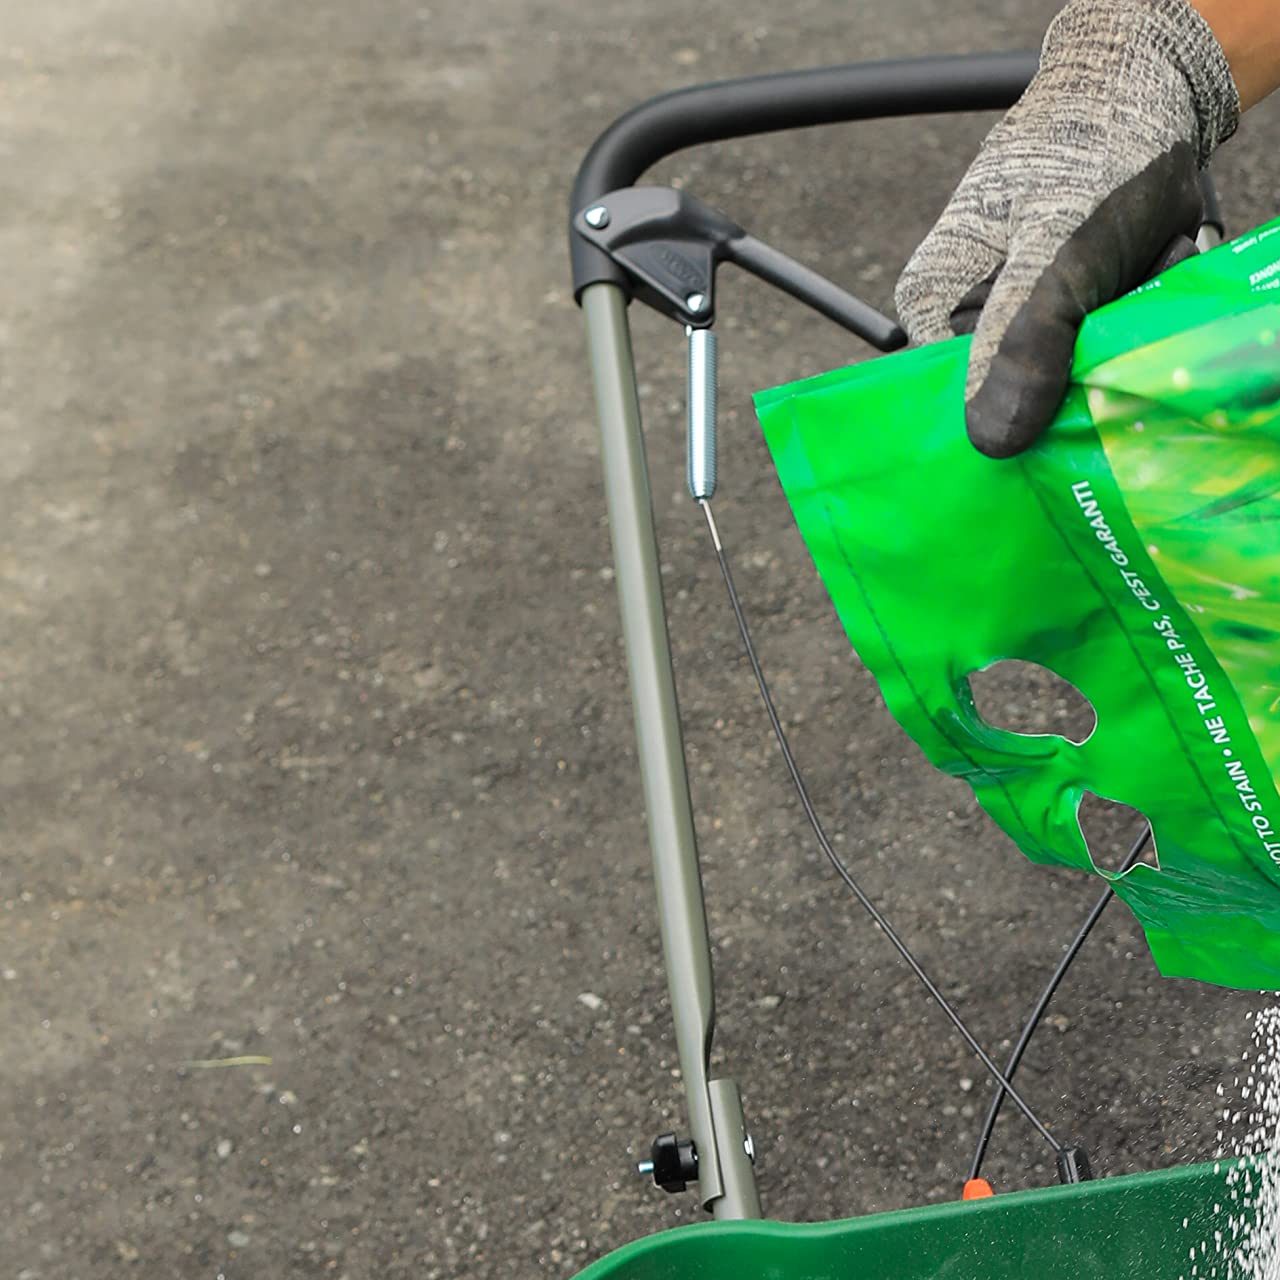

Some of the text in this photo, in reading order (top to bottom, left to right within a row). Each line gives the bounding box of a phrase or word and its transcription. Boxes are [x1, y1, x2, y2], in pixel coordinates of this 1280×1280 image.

[1071, 480, 1130, 568] GARANTI
[1122, 569, 1161, 612] C'EST
[1153, 614, 1183, 652] PAS,
[1175, 653, 1216, 715] TACHE
[1204, 715, 1231, 744] NE
[1225, 759, 1263, 815] STAIN
[1251, 813, 1276, 843] TO
